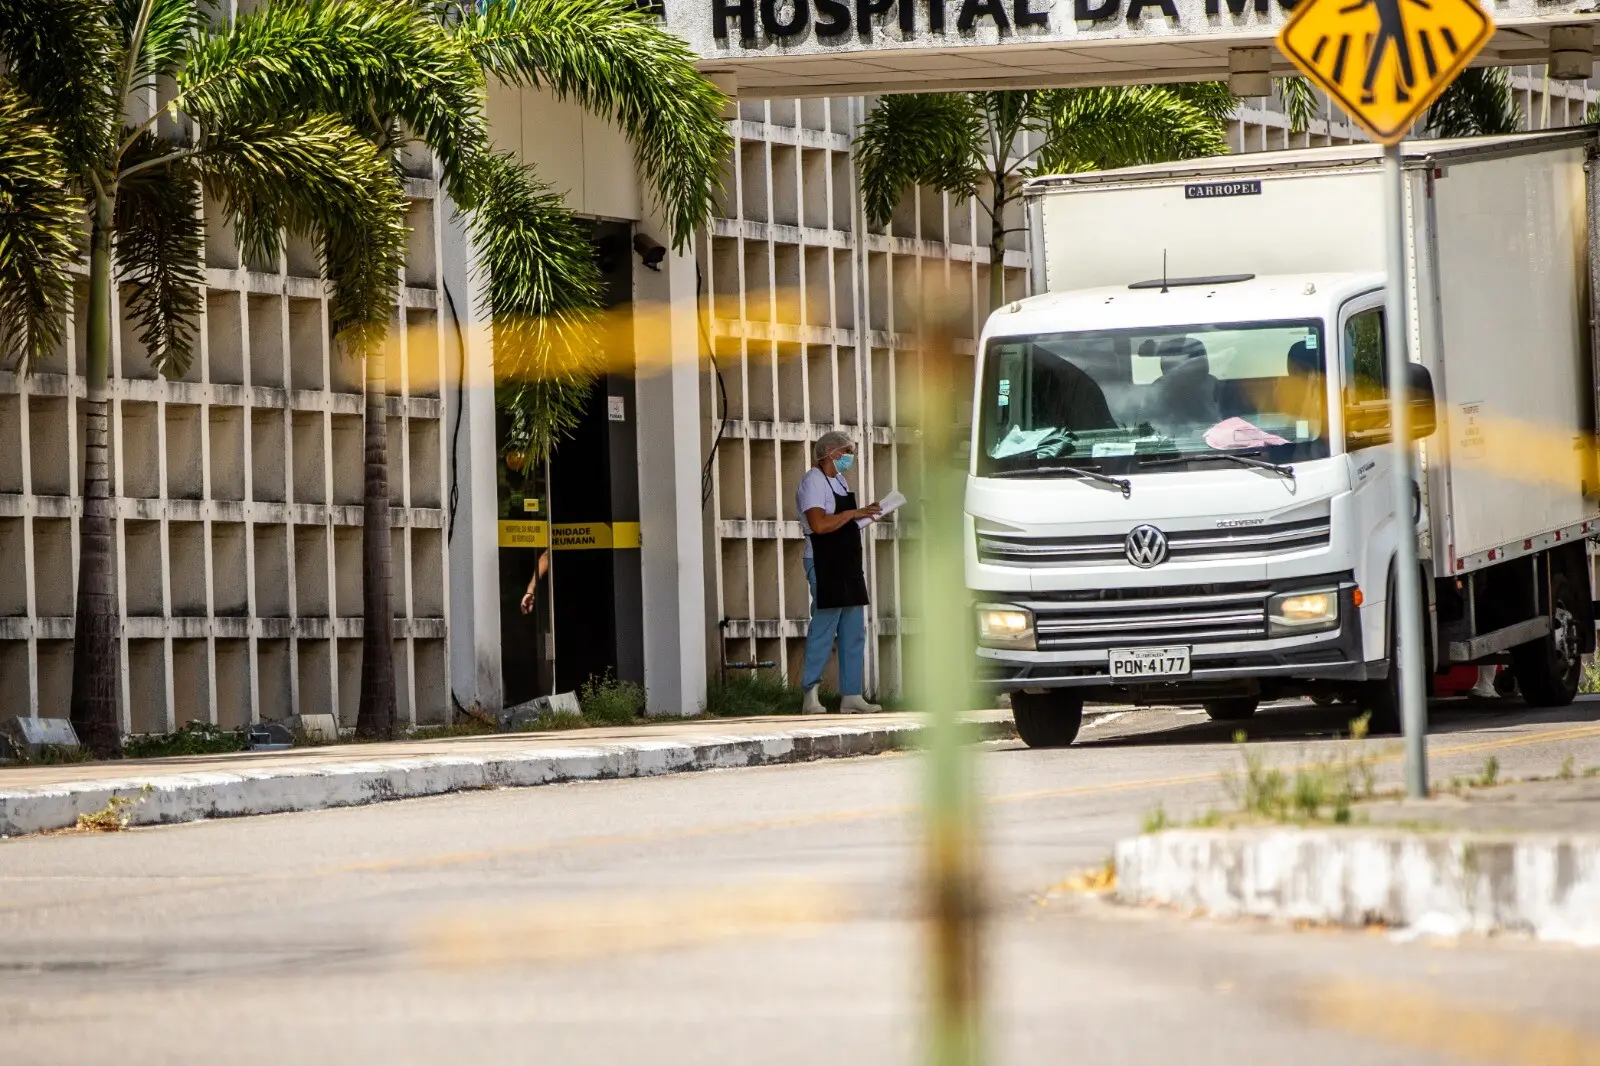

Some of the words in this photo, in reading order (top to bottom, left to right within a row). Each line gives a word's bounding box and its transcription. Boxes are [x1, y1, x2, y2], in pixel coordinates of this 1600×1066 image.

[1187, 183, 1258, 197] CARROPEL
[1216, 518, 1264, 527] DELIVERY
[1114, 657, 1185, 674] PON-4177
